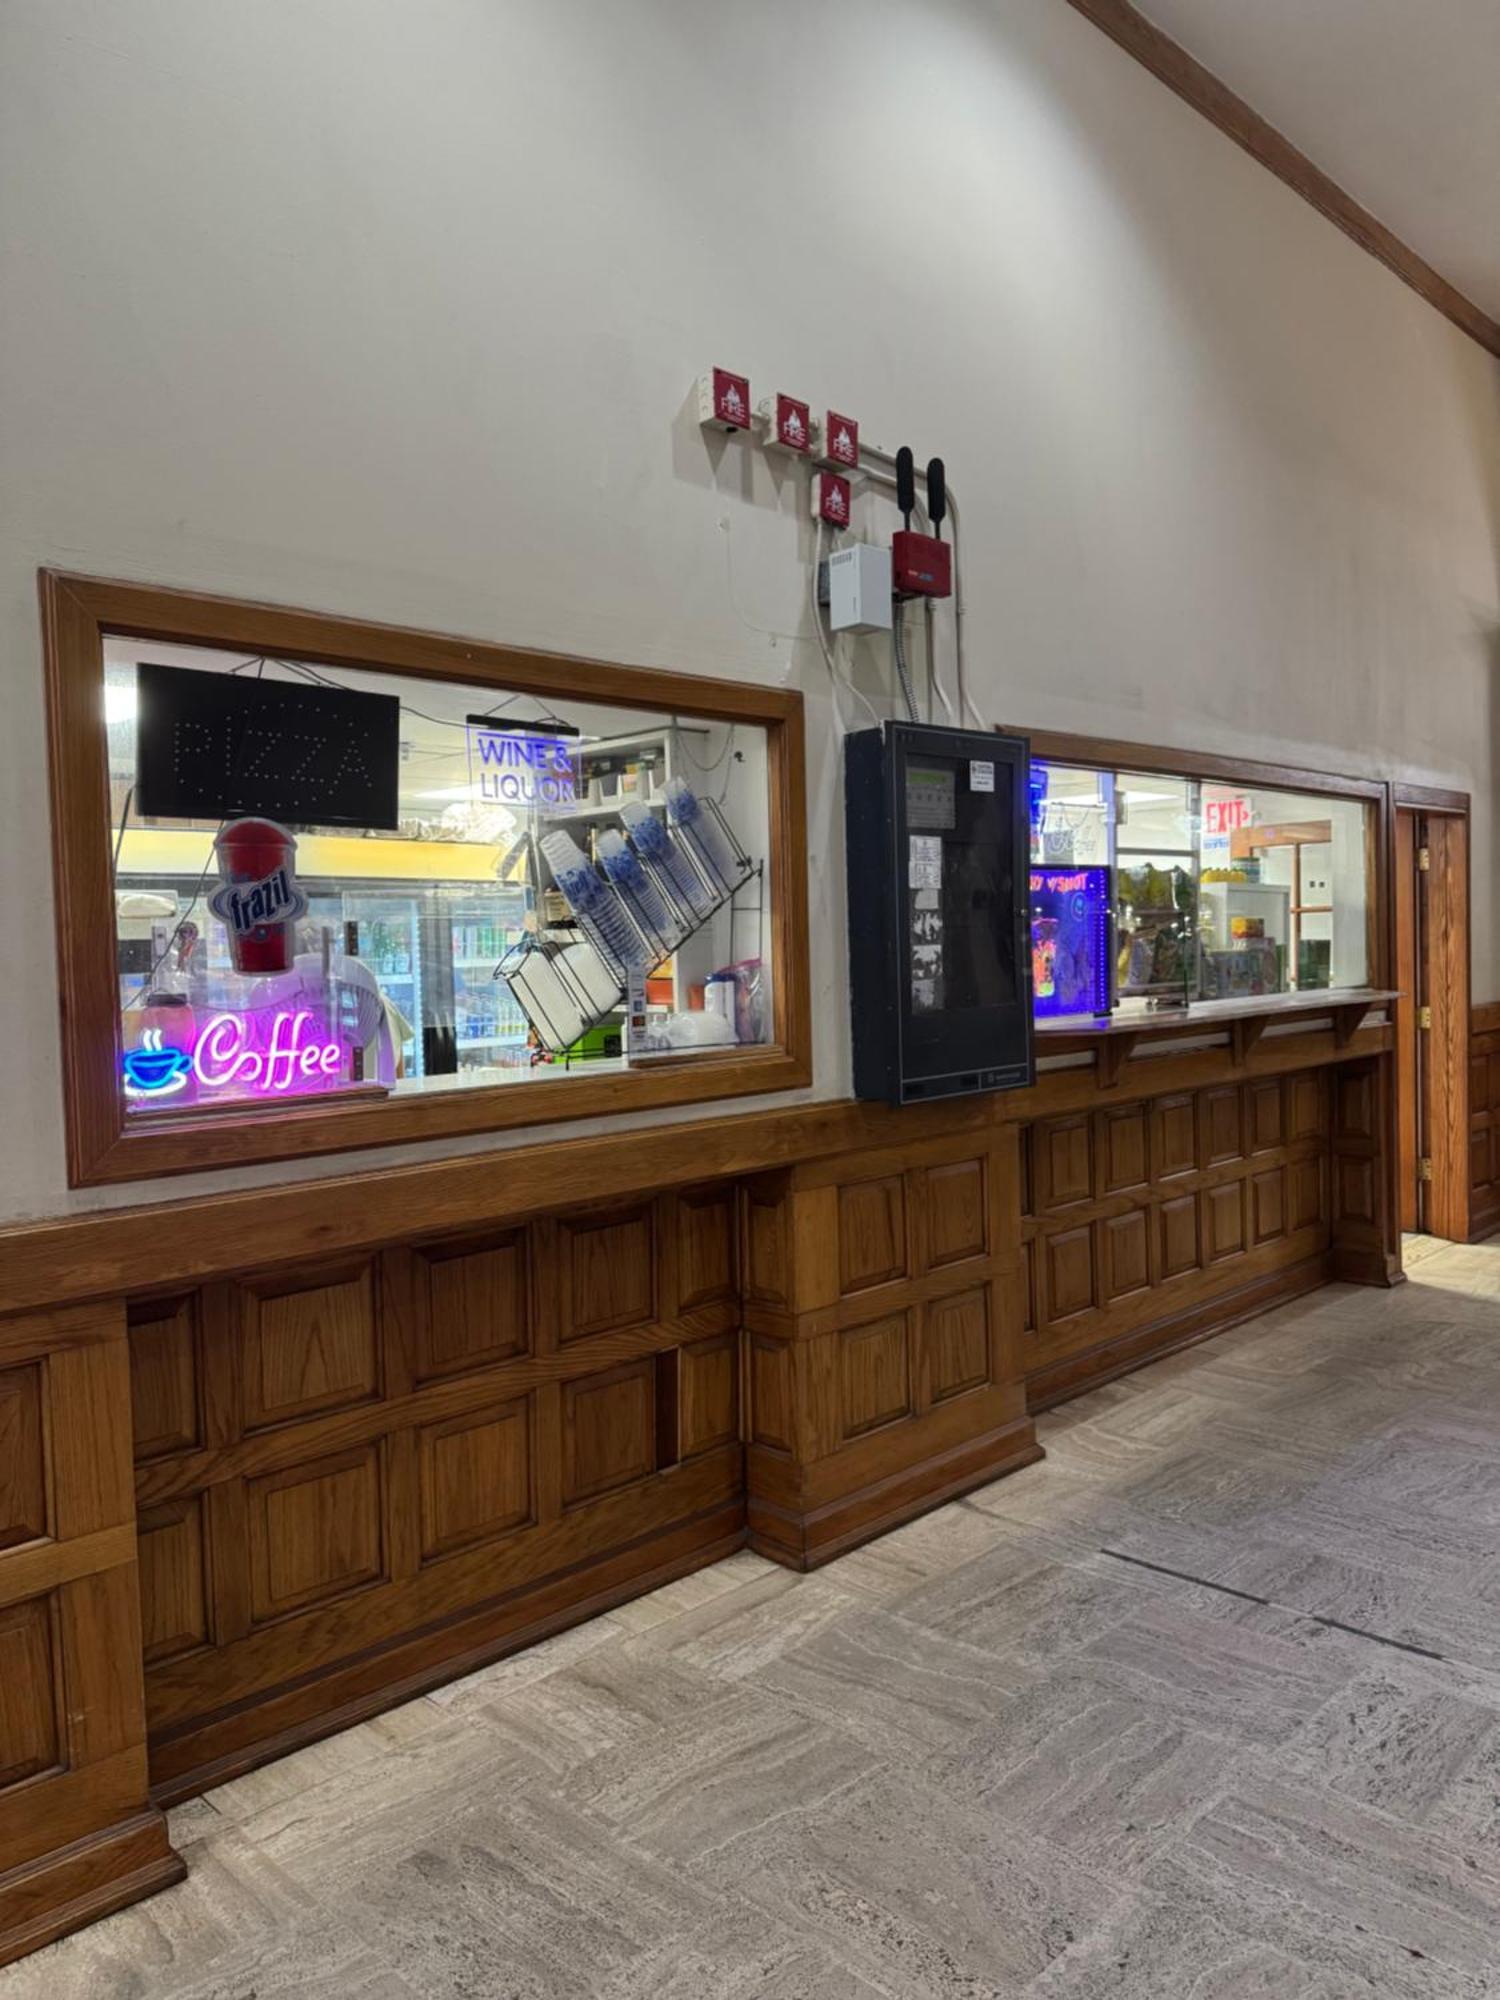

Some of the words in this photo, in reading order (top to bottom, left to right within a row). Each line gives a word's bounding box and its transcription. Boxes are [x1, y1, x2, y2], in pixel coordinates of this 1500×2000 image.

[721, 396, 745, 418] FIRE
[783, 421, 806, 442] FIRE
[833, 438, 855, 458] FIRE
[825, 498, 847, 517] FIRE
[174, 722, 372, 787] PIZZA
[478, 738, 547, 768] WINE
[554, 746, 572, 773] &
[481, 773, 577, 803] LIQUOR
[1206, 800, 1244, 832] EXIT
[230, 870, 290, 930] frazil
[194, 1011, 341, 1090] Coffee
